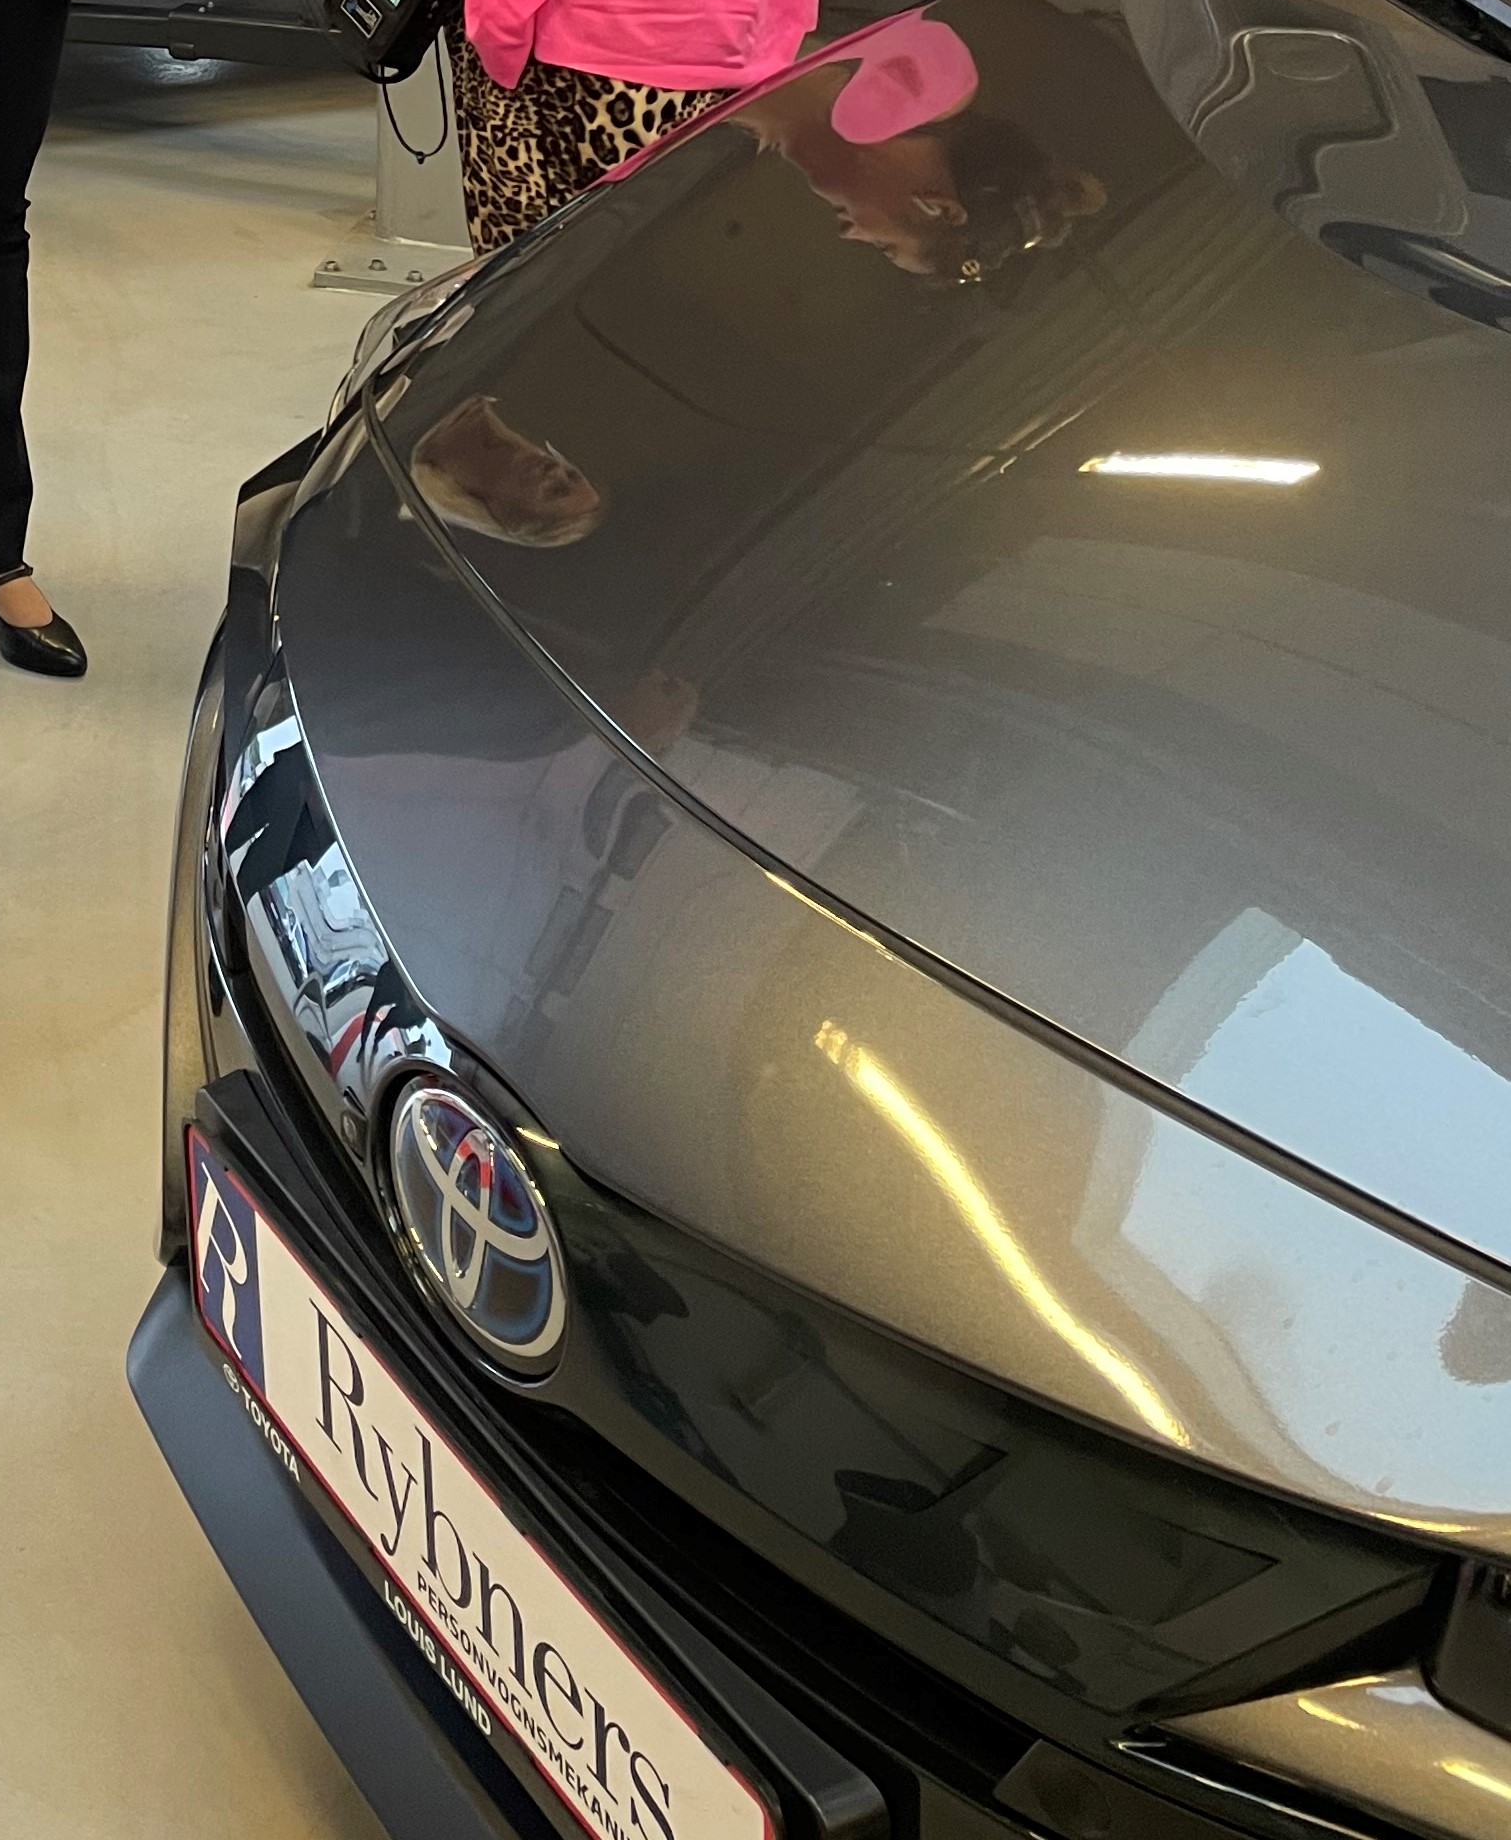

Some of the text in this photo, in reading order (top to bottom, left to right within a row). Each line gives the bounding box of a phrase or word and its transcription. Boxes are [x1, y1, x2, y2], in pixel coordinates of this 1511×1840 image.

[240, 1385, 301, 1484] TOYOTA
[309, 1297, 676, 1840] Rybners
[384, 1579, 492, 1737] LOUIS LUND
[417, 1570, 631, 1840] PERSONVOGNSMEKAN
